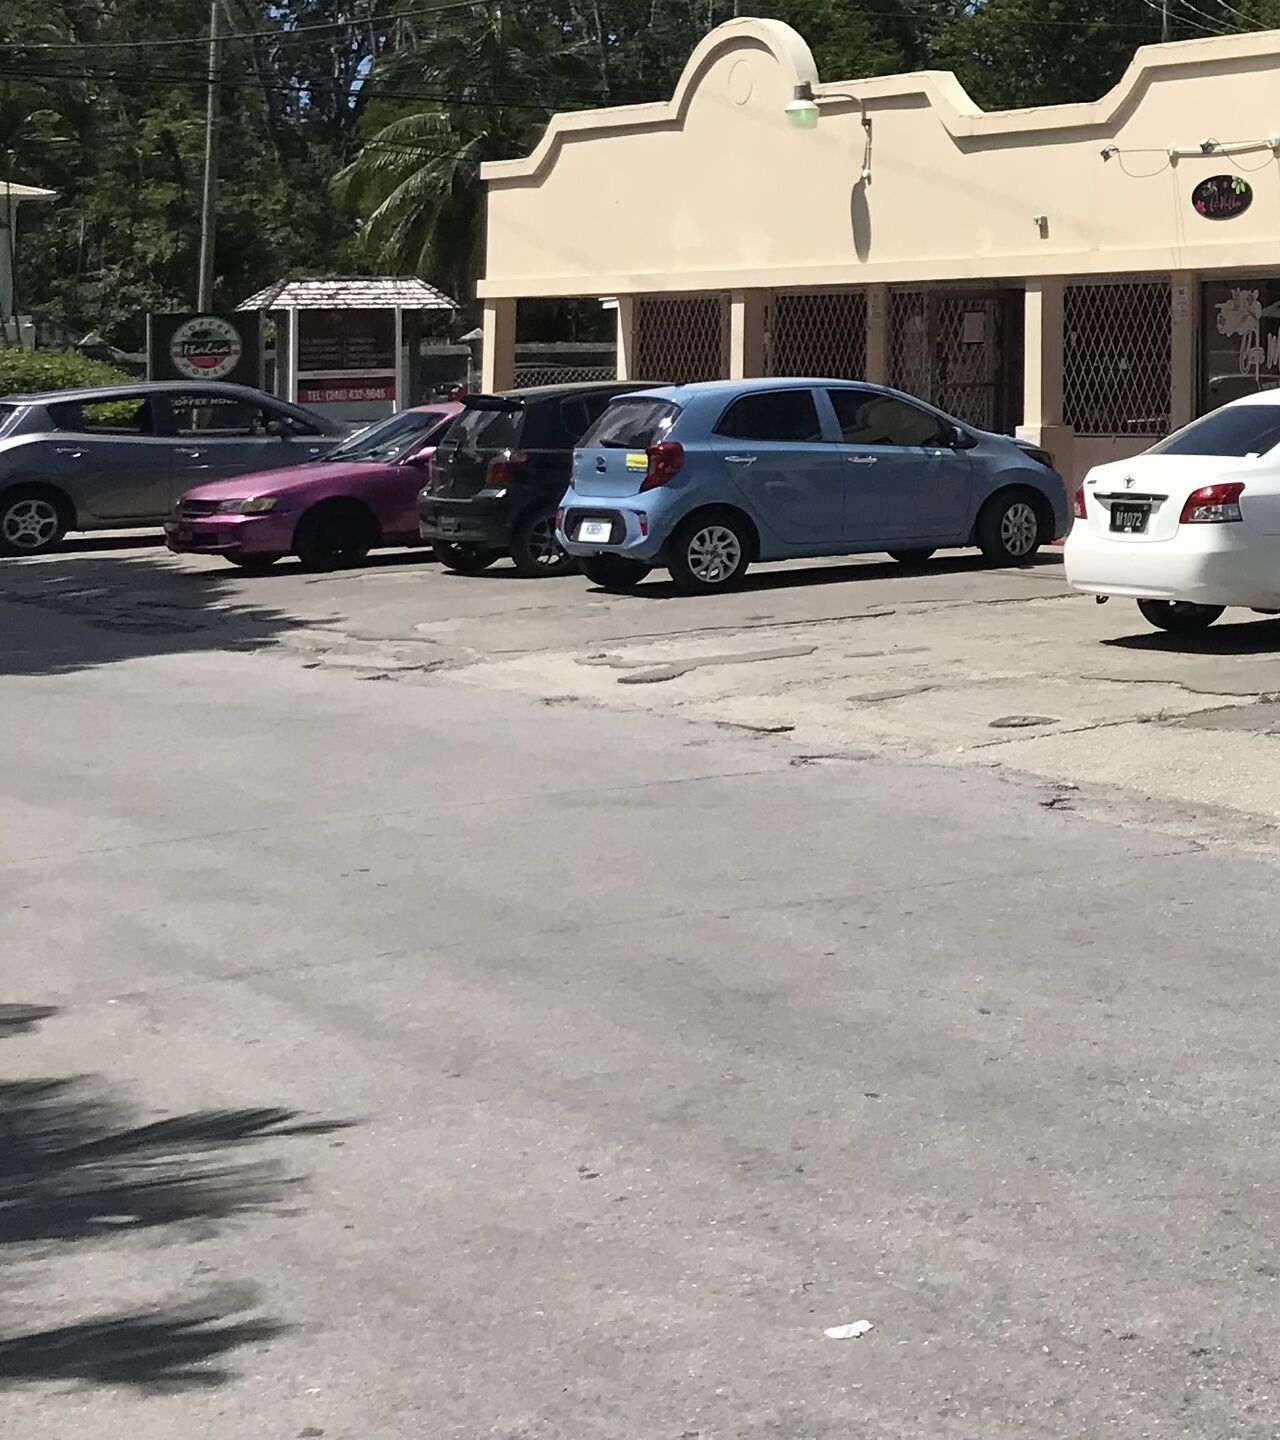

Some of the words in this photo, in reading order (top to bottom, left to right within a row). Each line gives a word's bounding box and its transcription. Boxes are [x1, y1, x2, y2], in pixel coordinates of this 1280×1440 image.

[181, 320, 233, 338] COFFEE
[182, 362, 225, 376] HOUSE
[1115, 511, 1143, 527] M1072
